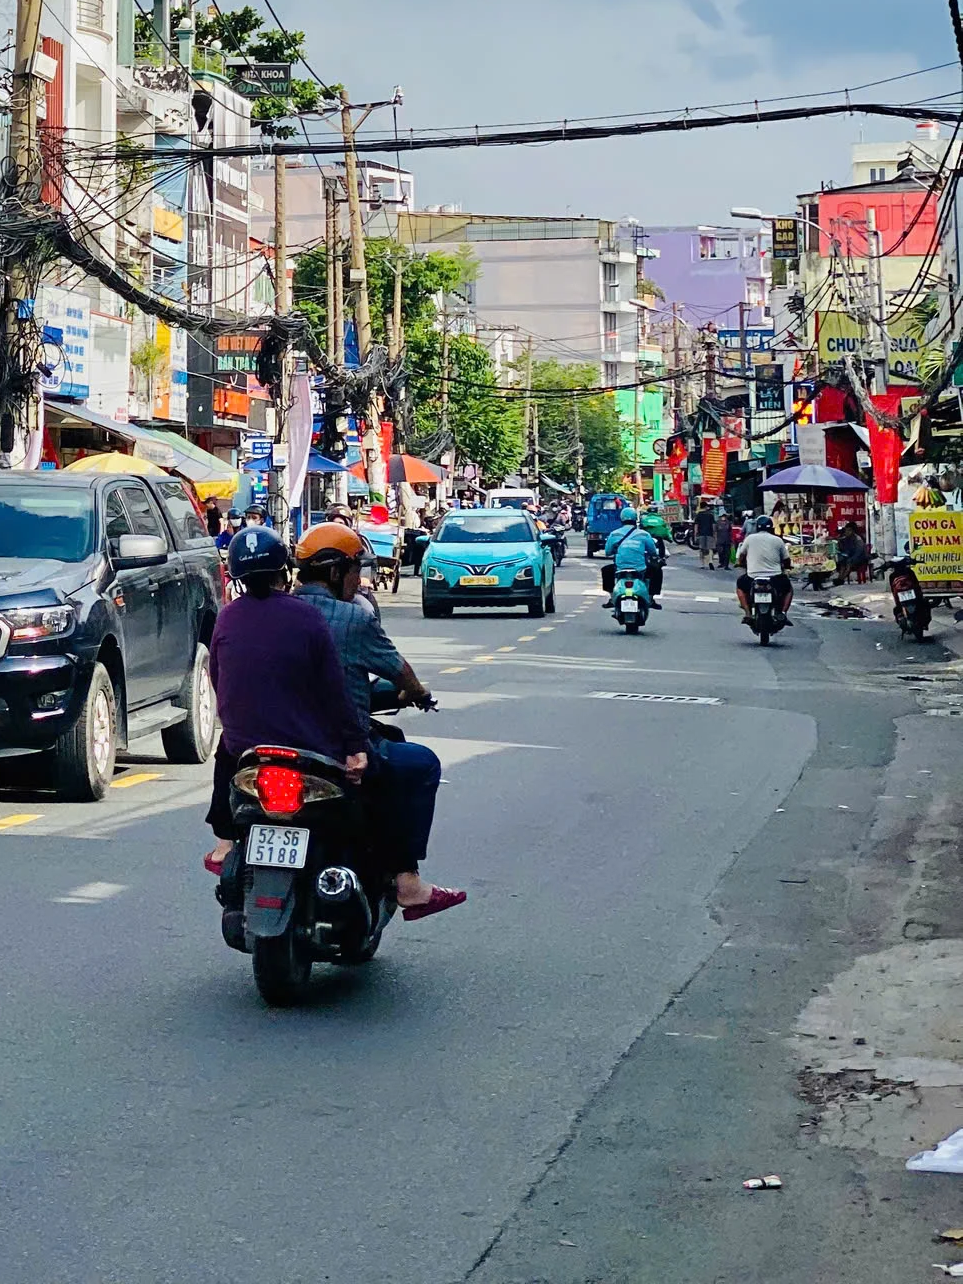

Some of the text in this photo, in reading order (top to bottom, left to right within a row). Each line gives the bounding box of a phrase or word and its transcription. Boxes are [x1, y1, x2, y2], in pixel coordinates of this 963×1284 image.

[261, 70, 285, 79] KHOA
[935, 535, 961, 546] NAM
[256, 846, 298, 865] 5188
